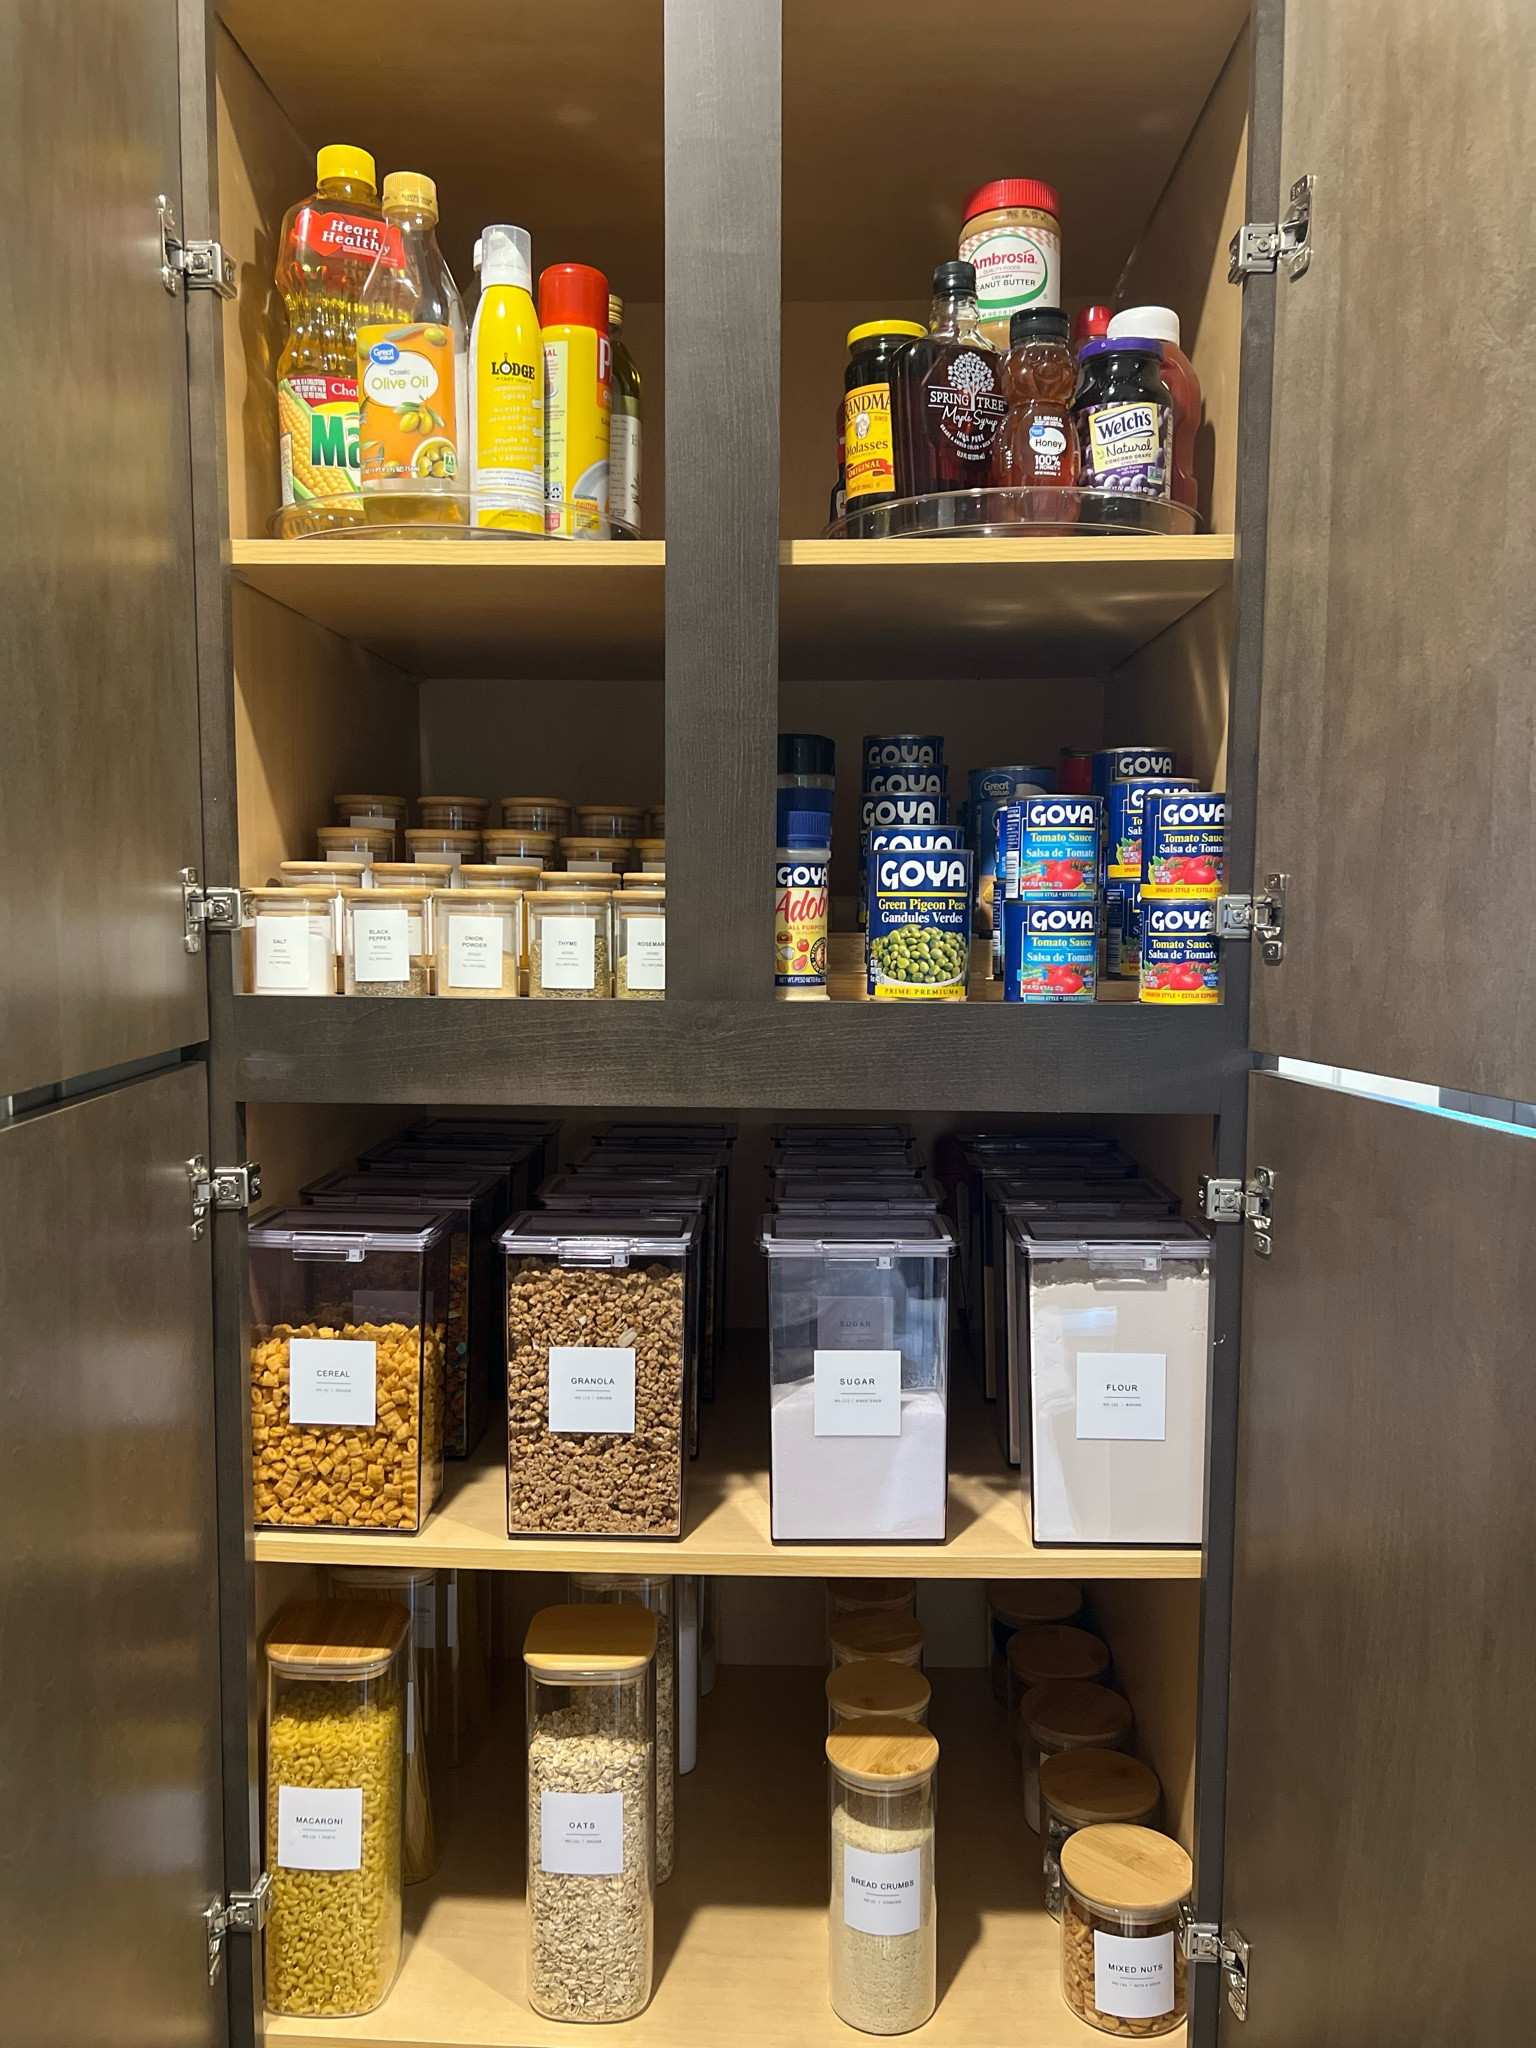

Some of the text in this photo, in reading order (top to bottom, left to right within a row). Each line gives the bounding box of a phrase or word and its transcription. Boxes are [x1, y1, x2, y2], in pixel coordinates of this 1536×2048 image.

[331, 219, 379, 239] Heart
[322, 230, 390, 254] Healthy
[1003, 279, 1036, 287] BUTTER
[373, 348, 395, 357] Great
[491, 361, 535, 380] LODGE
[371, 375, 429, 390] Olive Oil
[930, 391, 1005, 411] SPRING TREE
[942, 405, 998, 432] Maple Syrup
[1097, 411, 1151, 439] Welch's
[846, 440, 888, 458] Molasses
[1036, 439, 1063, 449] Honey
[1106, 438, 1152, 457] Natural
[1035, 455, 1061, 466] 100%
[1119, 757, 1172, 775] GOYA
[984, 781, 1009, 791] Great
[989, 789, 1009, 797] Value
[863, 801, 936, 827] GOYA
[1030, 805, 1094, 826] GOYA
[1163, 804, 1225, 825] GOYA
[1030, 832, 1092, 843] Tomato Sauce
[1164, 833, 1199, 843] Tomato
[1026, 848, 1095, 858] Salsa de Tomate
[1159, 844, 1184, 853] Salsa
[1184, 844, 1198, 853] de
[777, 866, 827, 887] GOYA
[880, 859, 965, 890] GOYA
[775, 885, 828, 923] Adob
[878, 898, 966, 912] Green Pigeon Peas
[881, 911, 963, 923] Gandules Verdes
[1031, 910, 1093, 931] GOYA
[1151, 910, 1212, 931] GOYA
[1031, 937, 1092, 947] Tomato Sauce
[1151, 939, 1214, 949] Tomato Sauce
[1026, 952, 1094, 962] Salsa de Tomate
[1148, 949, 1218, 959] Salsa de Tomate
[884, 987, 911, 995] PRIME
[316, 1370, 350, 1378] CEREAL
[571, 1377, 615, 1385] GRANOLA
[840, 1378, 875, 1386] SUGAR
[296, 1816, 343, 1825] MACARONI
[851, 1876, 914, 1890] BREAD CRUMBS
[1108, 1963, 1163, 1973] MIXED NUTS
